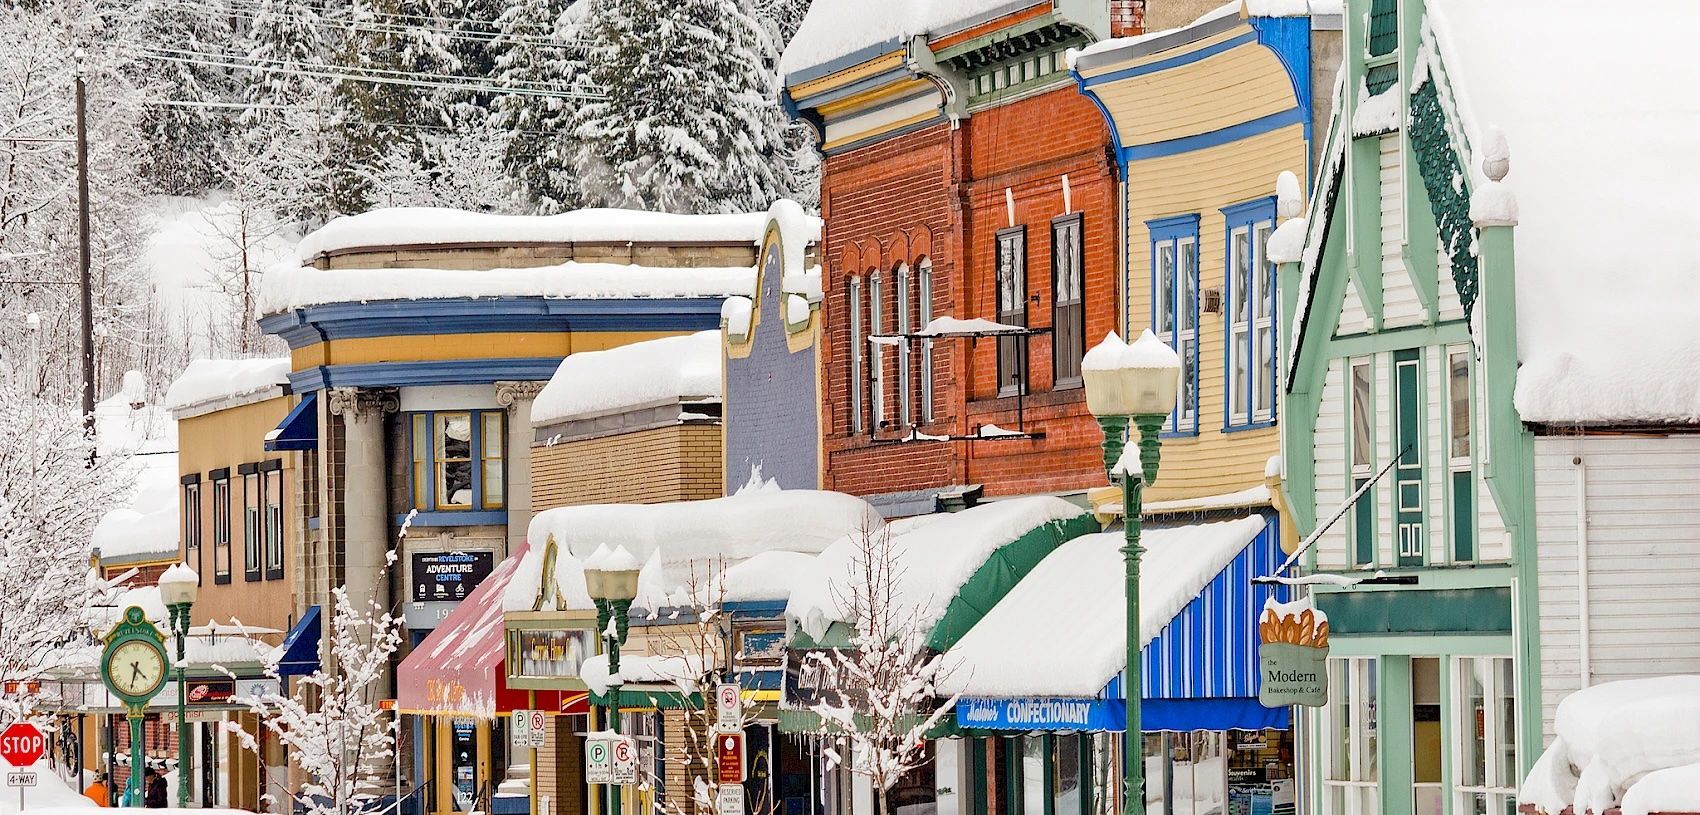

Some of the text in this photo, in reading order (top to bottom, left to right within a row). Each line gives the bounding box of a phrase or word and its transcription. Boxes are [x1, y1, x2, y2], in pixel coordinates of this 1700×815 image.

[426, 564, 473, 574] ADVENTURE
[436, 609, 454, 620] 19
[1268, 669, 1317, 682] Modern
[1268, 687, 1298, 695] Bakeshop
[1006, 702, 1090, 724] CONFECTIONARY
[3, 735, 41, 754] STOP
[1228, 768, 1256, 776] Souvenirs
[9, 775, 35, 784] 4-WAY
[457, 791, 473, 803] 122
[723, 796, 740, 804] PARKING
